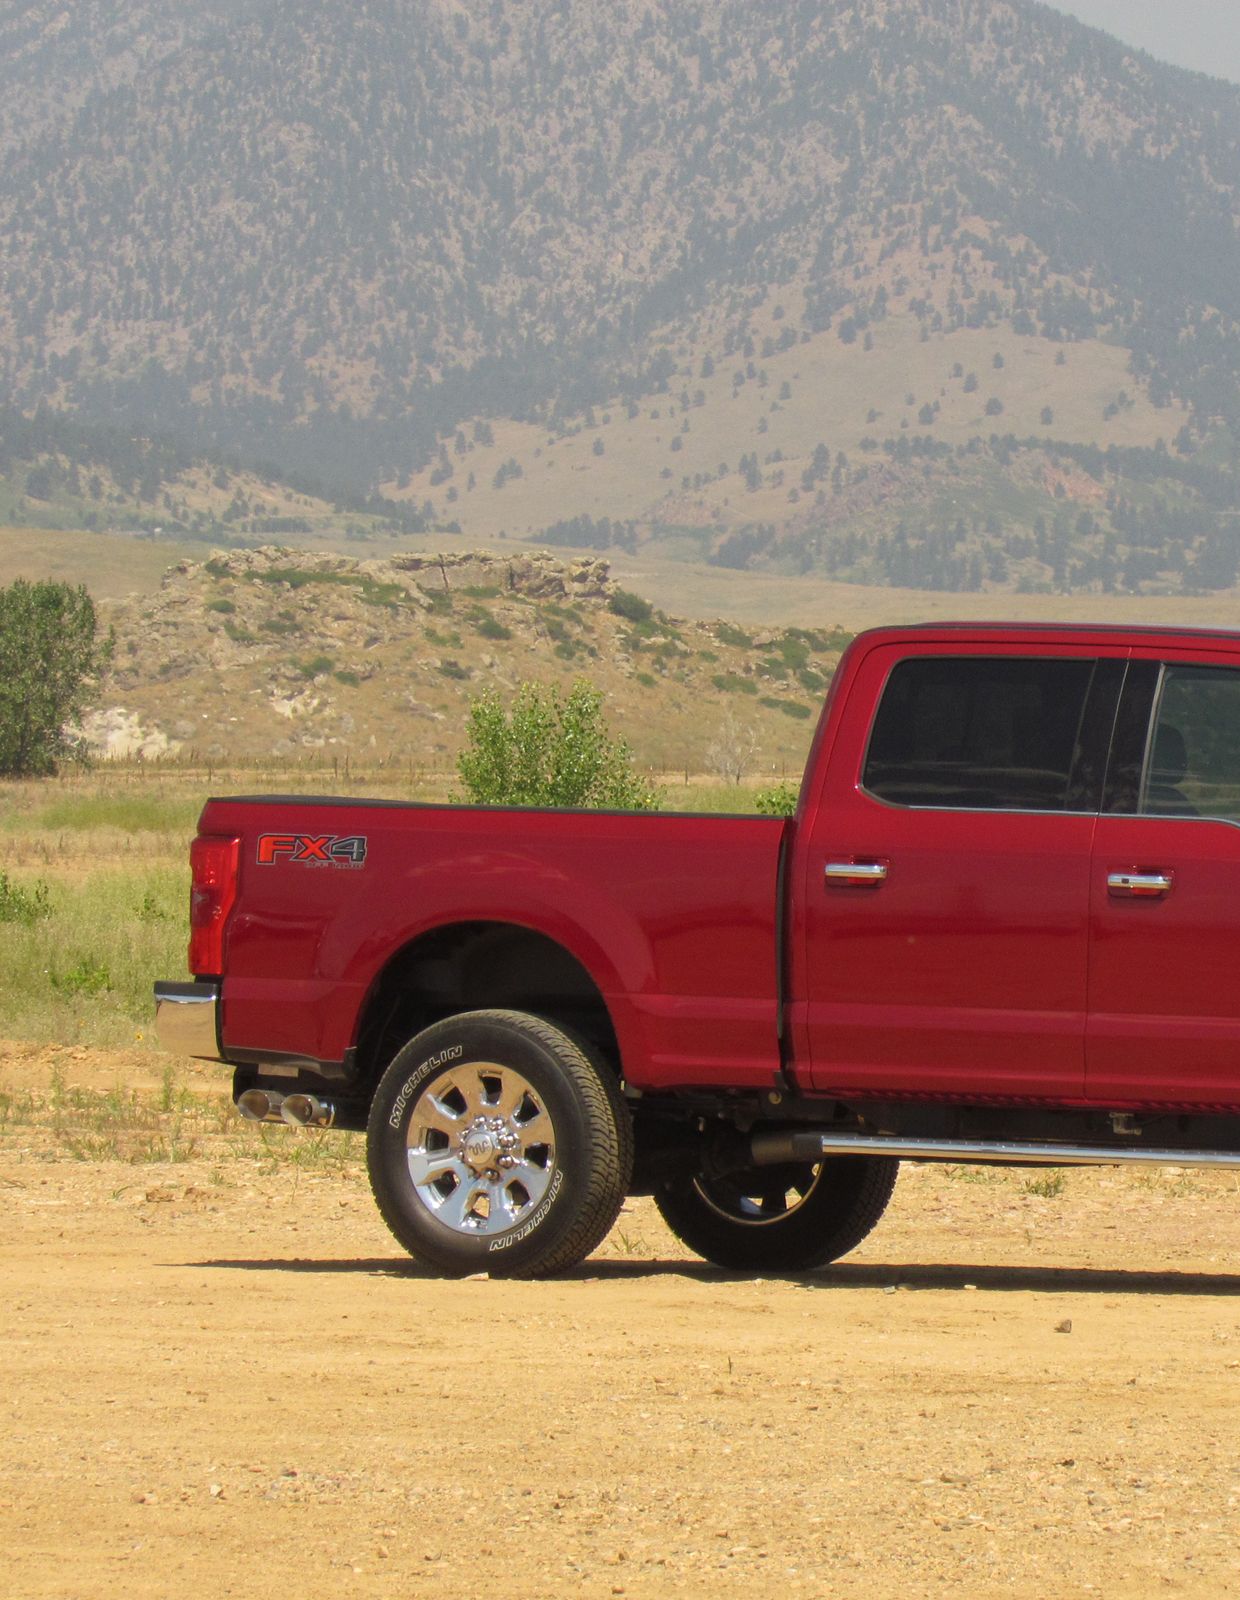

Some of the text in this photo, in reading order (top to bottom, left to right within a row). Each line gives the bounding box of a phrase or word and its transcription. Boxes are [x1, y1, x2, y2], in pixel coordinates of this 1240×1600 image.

[257, 833, 367, 864] FX4
[389, 1045, 463, 1129] MICHELIN
[489, 1170, 564, 1251] MICHELIN
